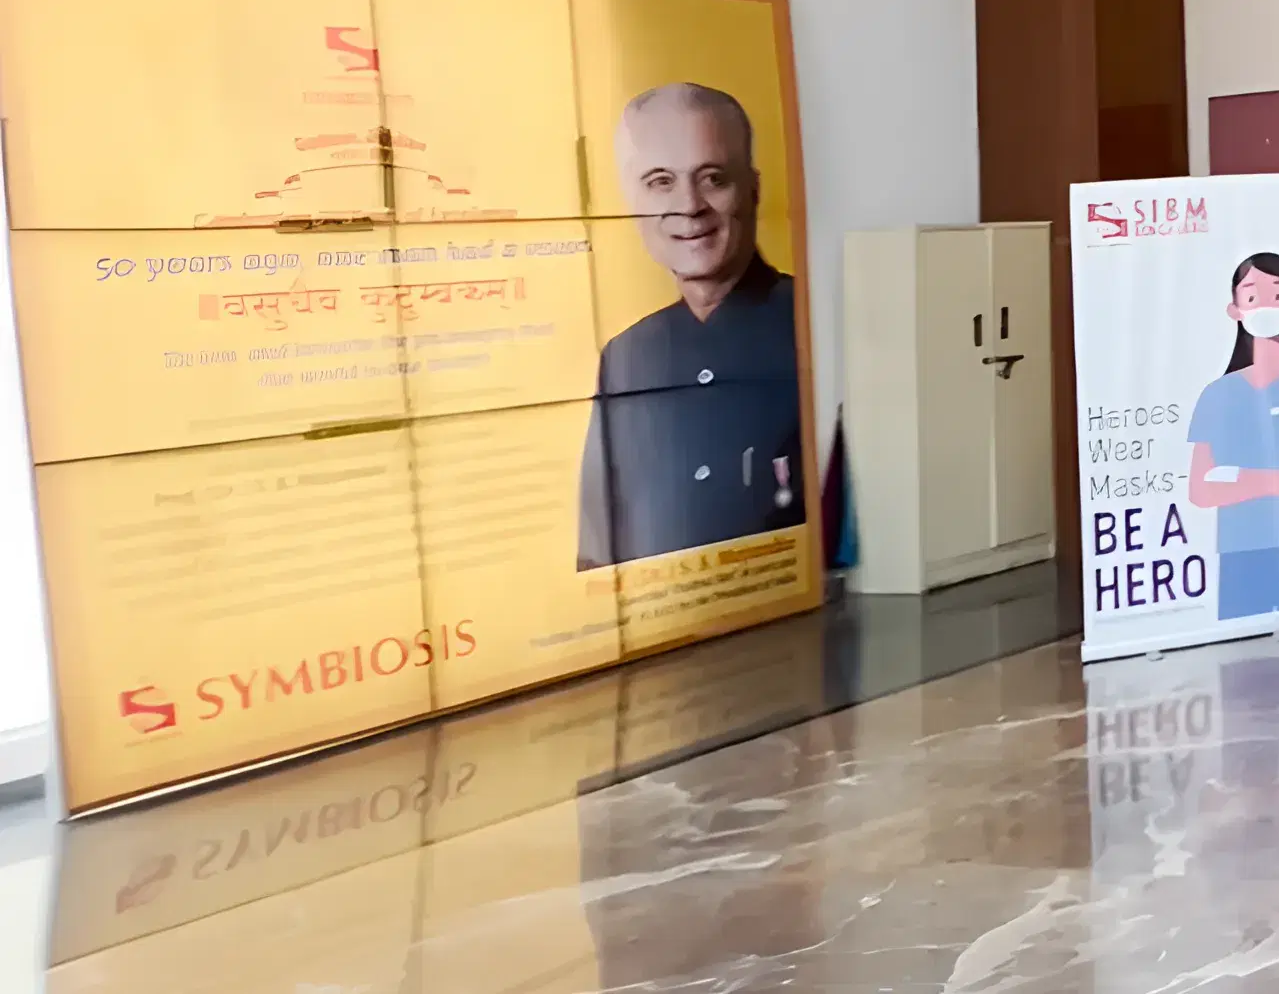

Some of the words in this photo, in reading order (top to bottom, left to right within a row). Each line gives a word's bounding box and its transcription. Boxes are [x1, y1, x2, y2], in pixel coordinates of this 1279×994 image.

[1134, 197, 1208, 224] SIBM
[1088, 403, 1180, 431] Heroes
[1088, 438, 1154, 463] Wear
[1094, 507, 1144, 556] BE
[1160, 503, 1188, 547] A
[1095, 554, 1207, 612] HERO
[195, 619, 477, 721] SYMBIOSIS
